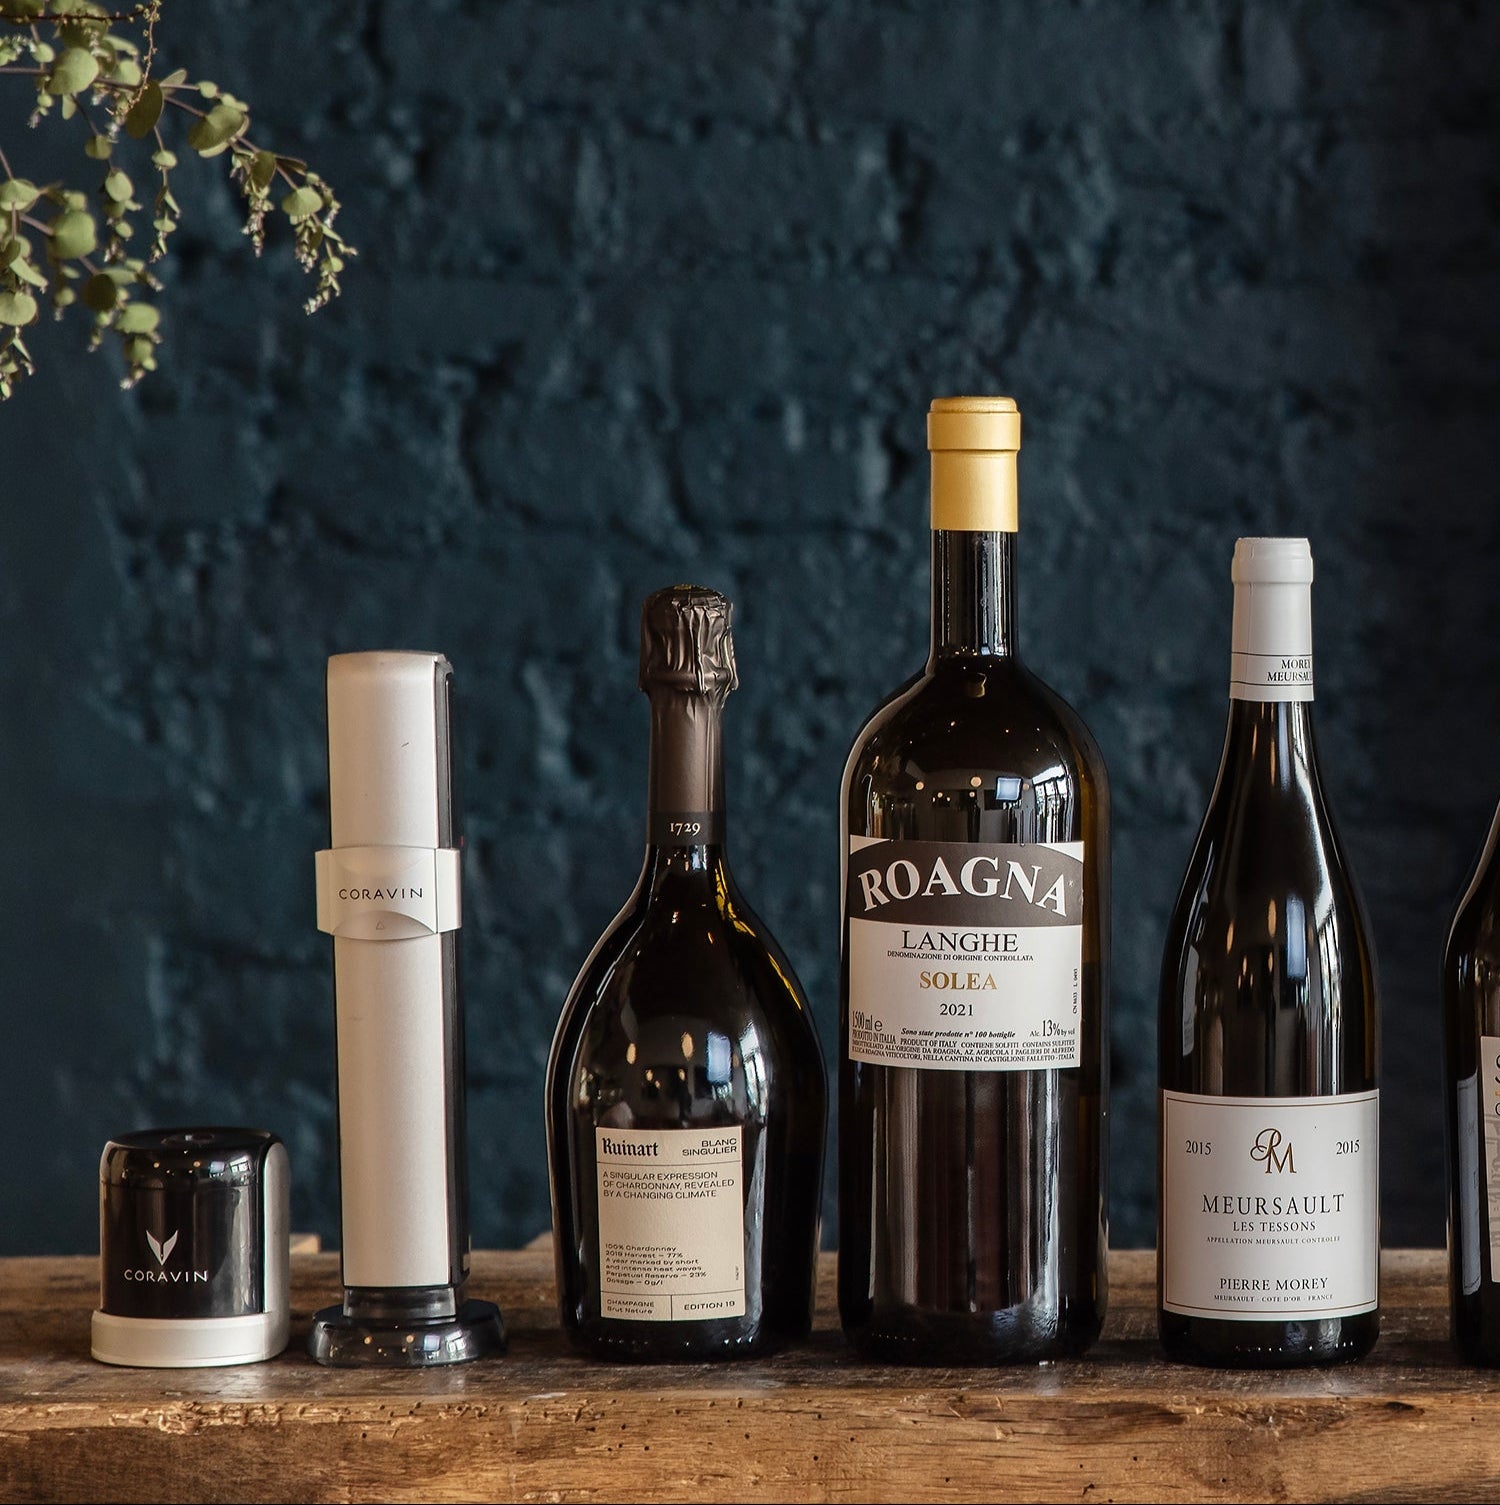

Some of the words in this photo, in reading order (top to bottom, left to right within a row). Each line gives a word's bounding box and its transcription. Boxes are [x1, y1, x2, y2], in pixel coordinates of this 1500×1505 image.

[1282, 659, 1310, 669] MOREY
[670, 822, 700, 836] 1729
[858, 856, 1067, 916] ROAGNA
[339, 888, 422, 900] CORAVIN
[902, 930, 1018, 952] LANGHE
[888, 950, 942, 960] DENOMINAZIONE
[920, 971, 998, 990] SOLEA
[940, 1004, 974, 1016] 2021
[852, 1010, 864, 1029] 1500
[874, 1020, 882, 1032] e
[1042, 1020, 1060, 1036] 13%
[852, 1030, 872, 1042] PRODOTTO
[880, 1034, 896, 1044] ITALIA
[934, 1030, 963, 1038] prodotte
[900, 1038, 928, 1046] PRODUCT
[929, 1039, 937, 1047] OF
[1022, 1040, 1052, 1048] CONTAINS
[884, 1043, 920, 1054] ALL'ORIGINE
[602, 1138, 659, 1157] Ruinart
[701, 1138, 737, 1148] BLANC
[1186, 1140, 1212, 1155] 2015
[1336, 1140, 1360, 1154] 2015
[682, 1146, 737, 1156] SINGULIER
[610, 1172, 655, 1180] SINGULAR
[658, 1172, 718, 1180] EXPRESSION
[603, 1180, 614, 1188] OF
[616, 1181, 682, 1190] CHARDONNAY,
[684, 1180, 734, 1189] REVEALED
[624, 1191, 674, 1200] CHANGING
[675, 1190, 717, 1199] CLIMATE
[1202, 1194, 1344, 1216] MEURSAULT
[1233, 1222, 1254, 1232] LES
[1260, 1221, 1316, 1232] TESSONS
[1207, 1236, 1252, 1244] APPELLATION
[605, 1243, 624, 1251] 100%
[626, 1244, 676, 1253] Chardonnay
[124, 1269, 208, 1282] CORAVIN
[606, 1271, 644, 1279] Perpetual
[606, 1278, 634, 1286] Dosage
[1220, 1278, 1270, 1290] PIERRE
[1276, 1278, 1328, 1290] MOREY
[606, 1299, 654, 1308] CHAMPAGNE
[684, 1302, 722, 1310] EDITION
